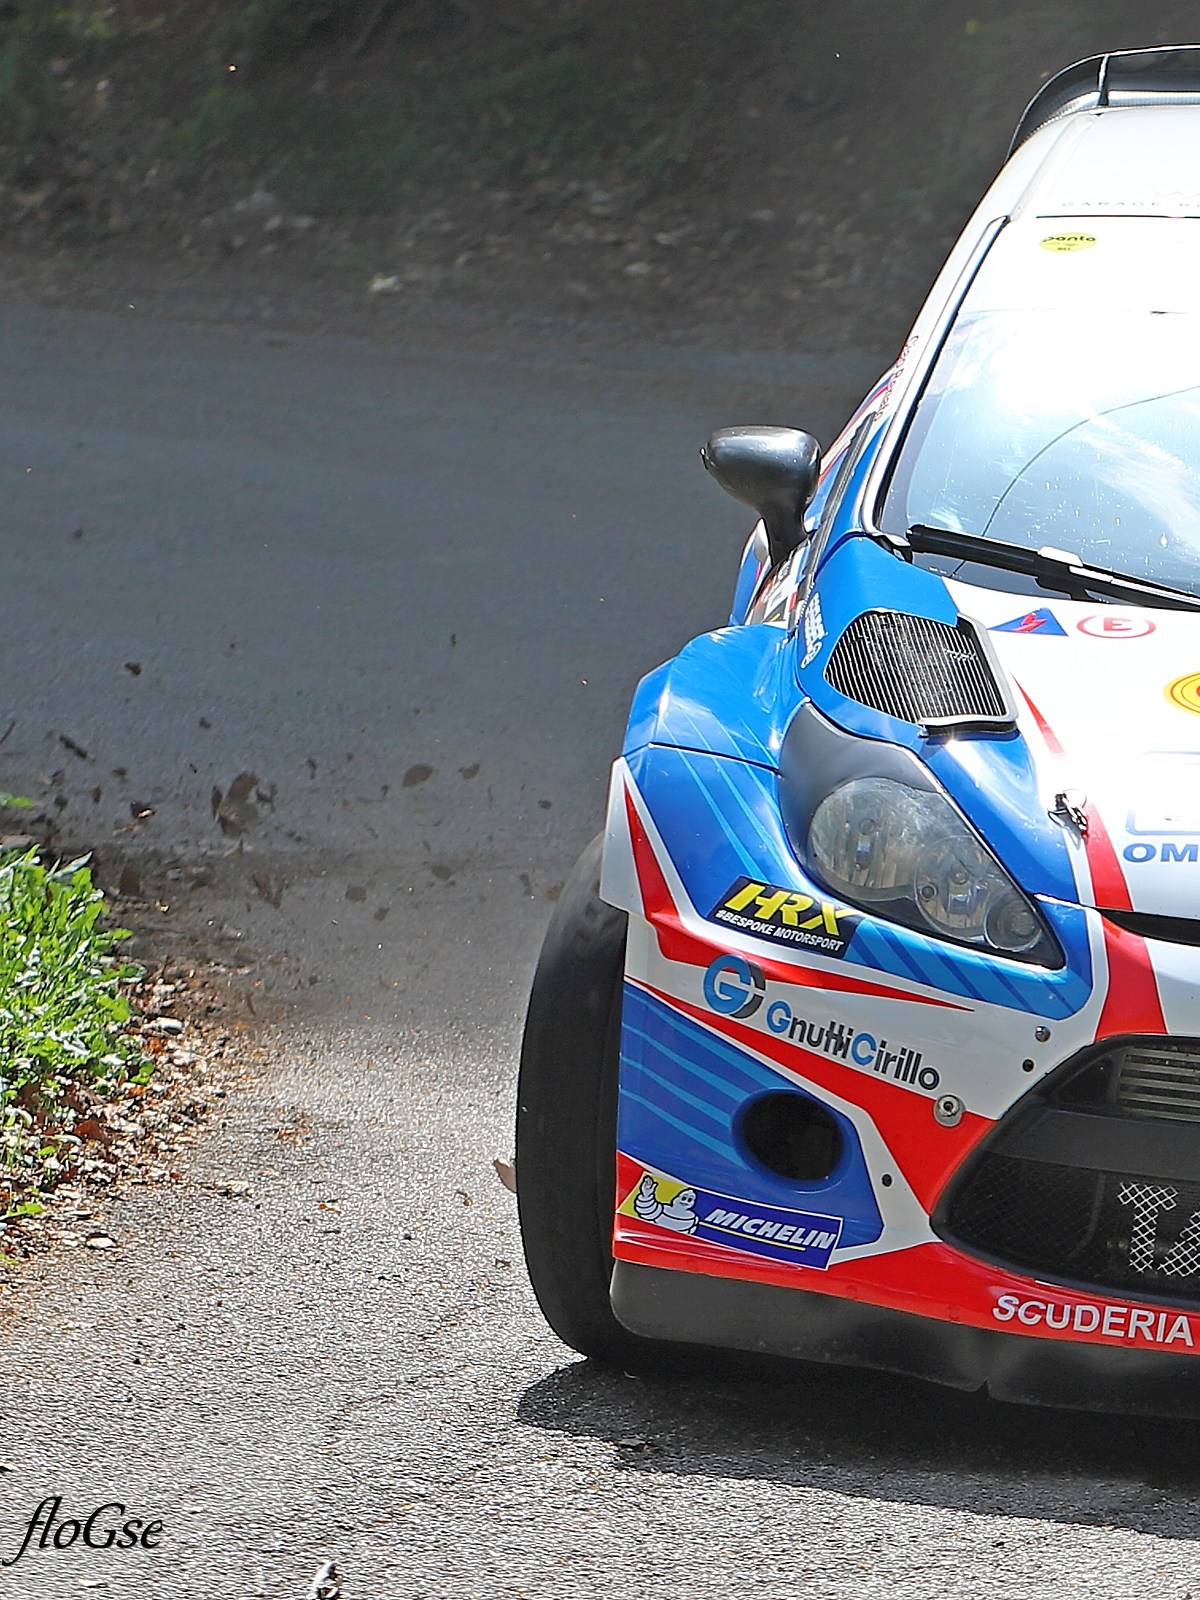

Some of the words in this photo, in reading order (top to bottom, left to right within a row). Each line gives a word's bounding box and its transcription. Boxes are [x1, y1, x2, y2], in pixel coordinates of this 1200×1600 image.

[715, 909, 774, 936] #BESPOKE
[774, 926, 844, 952] MOTORSPORT
[724, 882, 860, 936] HRX
[704, 1207, 838, 1250] MICHELIN
[991, 1294, 1195, 1345] SCUDERIA
